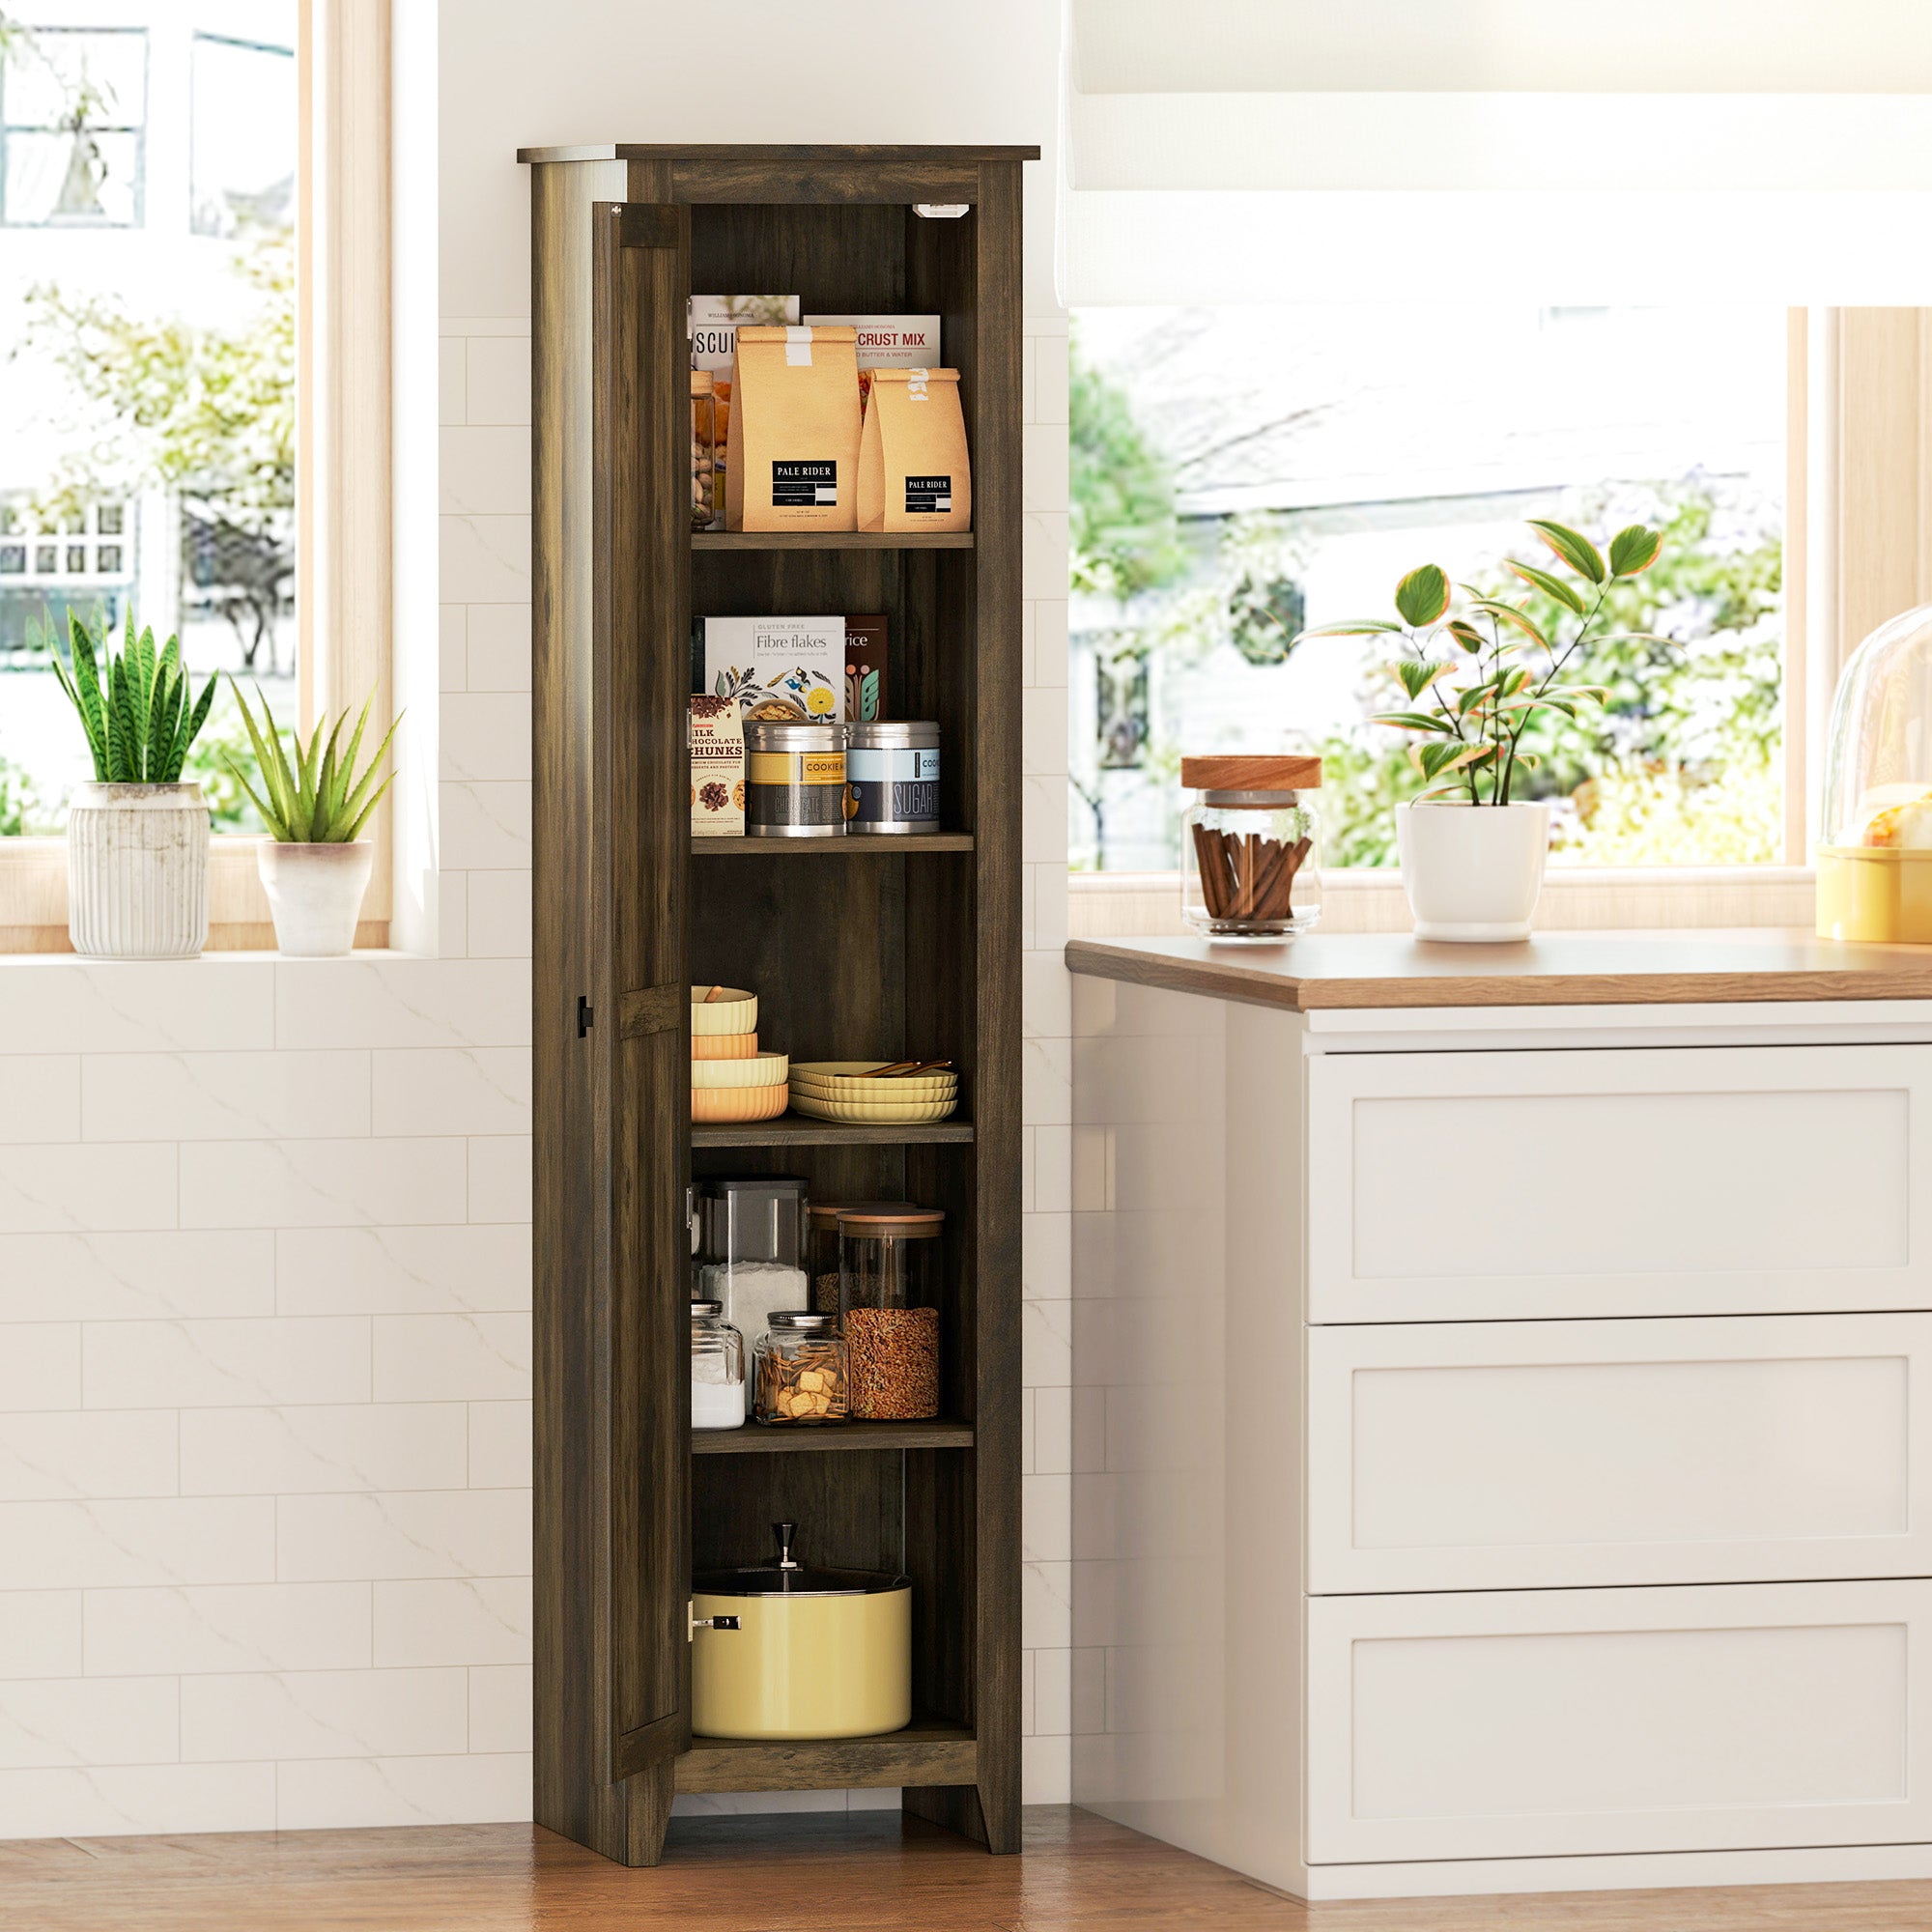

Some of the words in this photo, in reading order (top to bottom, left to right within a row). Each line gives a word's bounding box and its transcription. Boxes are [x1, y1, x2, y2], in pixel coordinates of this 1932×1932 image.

[858, 333, 898, 346] CRUST
[902, 333, 925, 346] MIX
[777, 467, 800, 476] PALE
[802, 467, 831, 476] RIDER
[757, 634, 788, 648] Fibre
[792, 634, 827, 648] flakes
[806, 763, 838, 771] COOKIE
[894, 784, 933, 814] SUGAR
